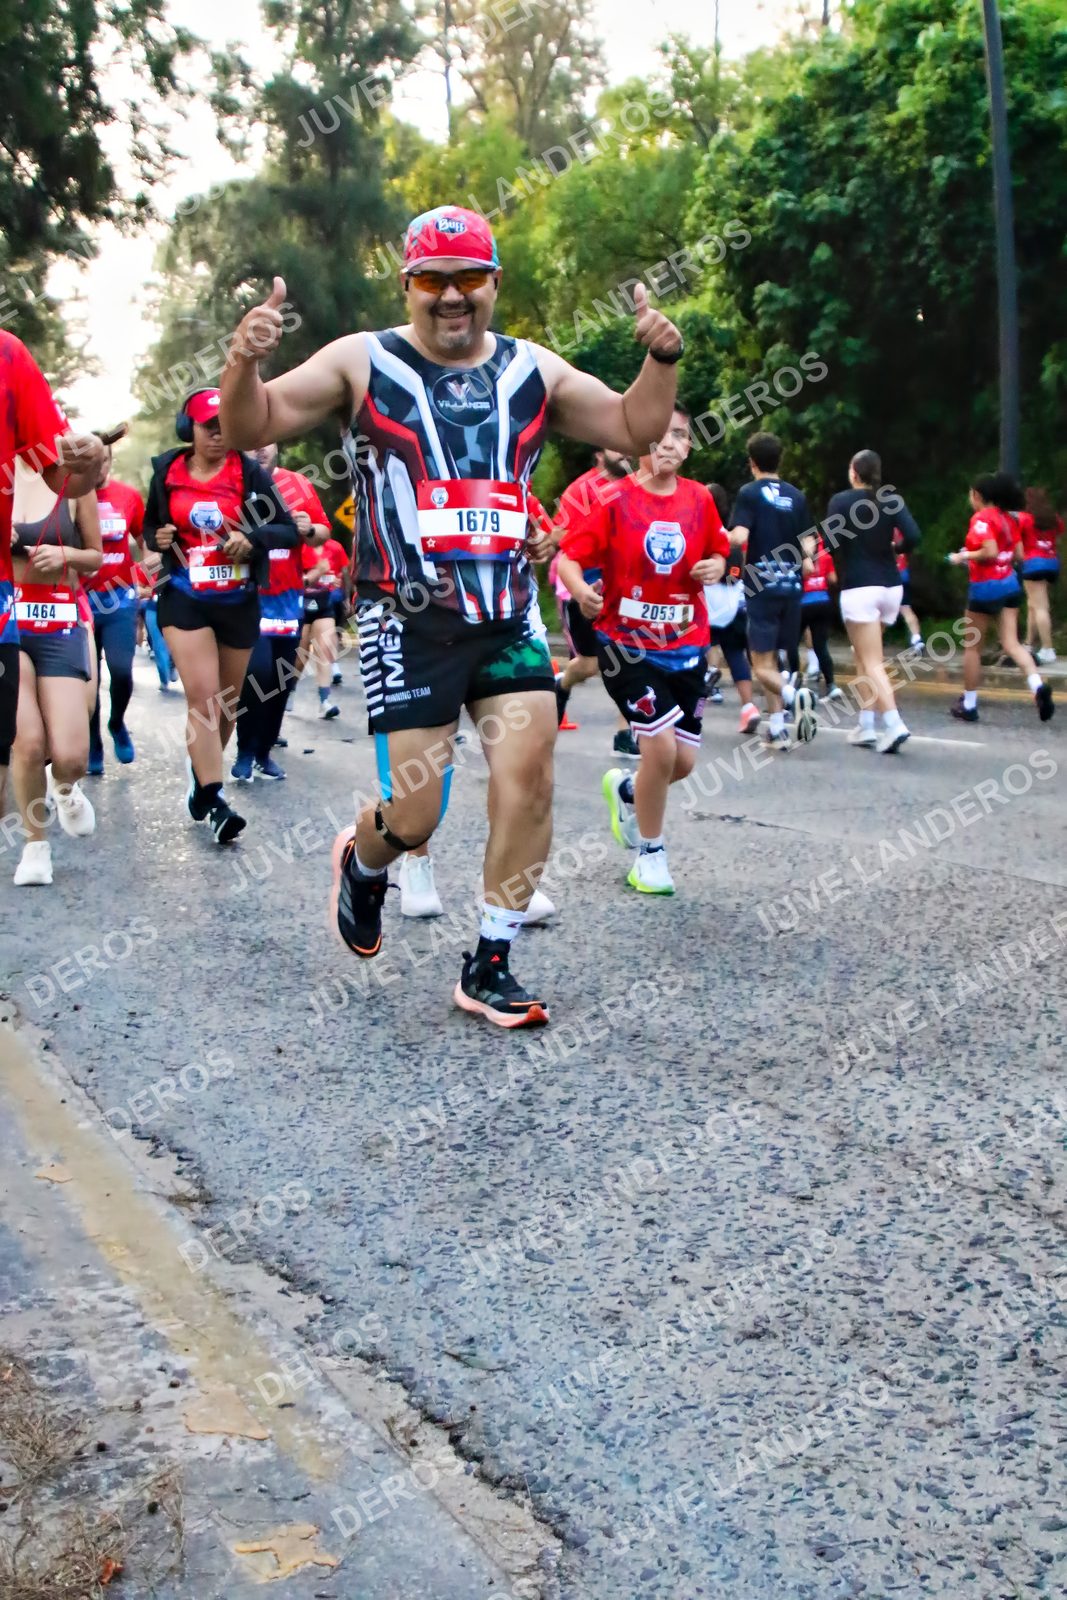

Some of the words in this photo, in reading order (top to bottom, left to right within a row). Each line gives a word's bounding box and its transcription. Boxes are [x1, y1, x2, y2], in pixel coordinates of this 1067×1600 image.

[456, 510, 501, 533] 1679
[209, 566, 233, 579] 3157
[26, 604, 56, 618] 1464
[641, 604, 676, 620] 2053
[412, 686, 431, 698] TEAM
